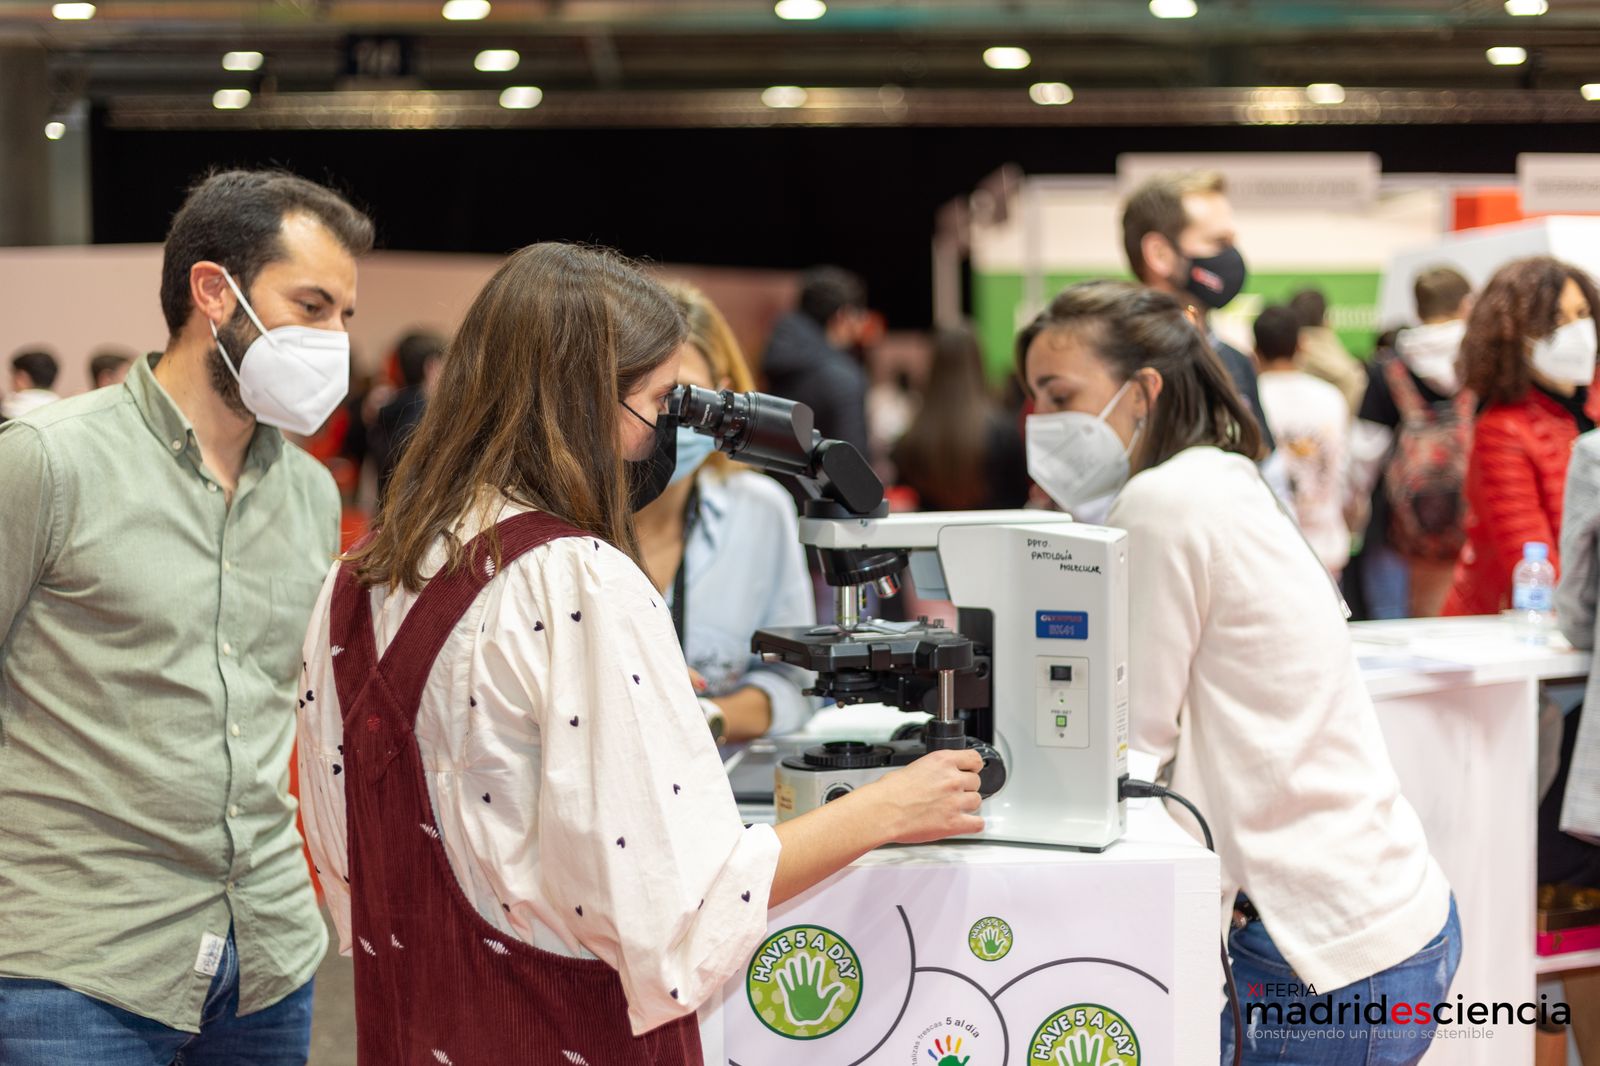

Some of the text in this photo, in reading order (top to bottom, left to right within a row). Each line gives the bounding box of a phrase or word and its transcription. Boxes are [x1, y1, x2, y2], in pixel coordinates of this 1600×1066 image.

[1031, 549, 1072, 560] PATOLOGÍA
[753, 931, 857, 982] HAVE 5 A DAY
[945, 1017, 953, 1026] 5
[954, 1020, 965, 1028] al
[1033, 1009, 1136, 1060] HAVE 5 A DAY
